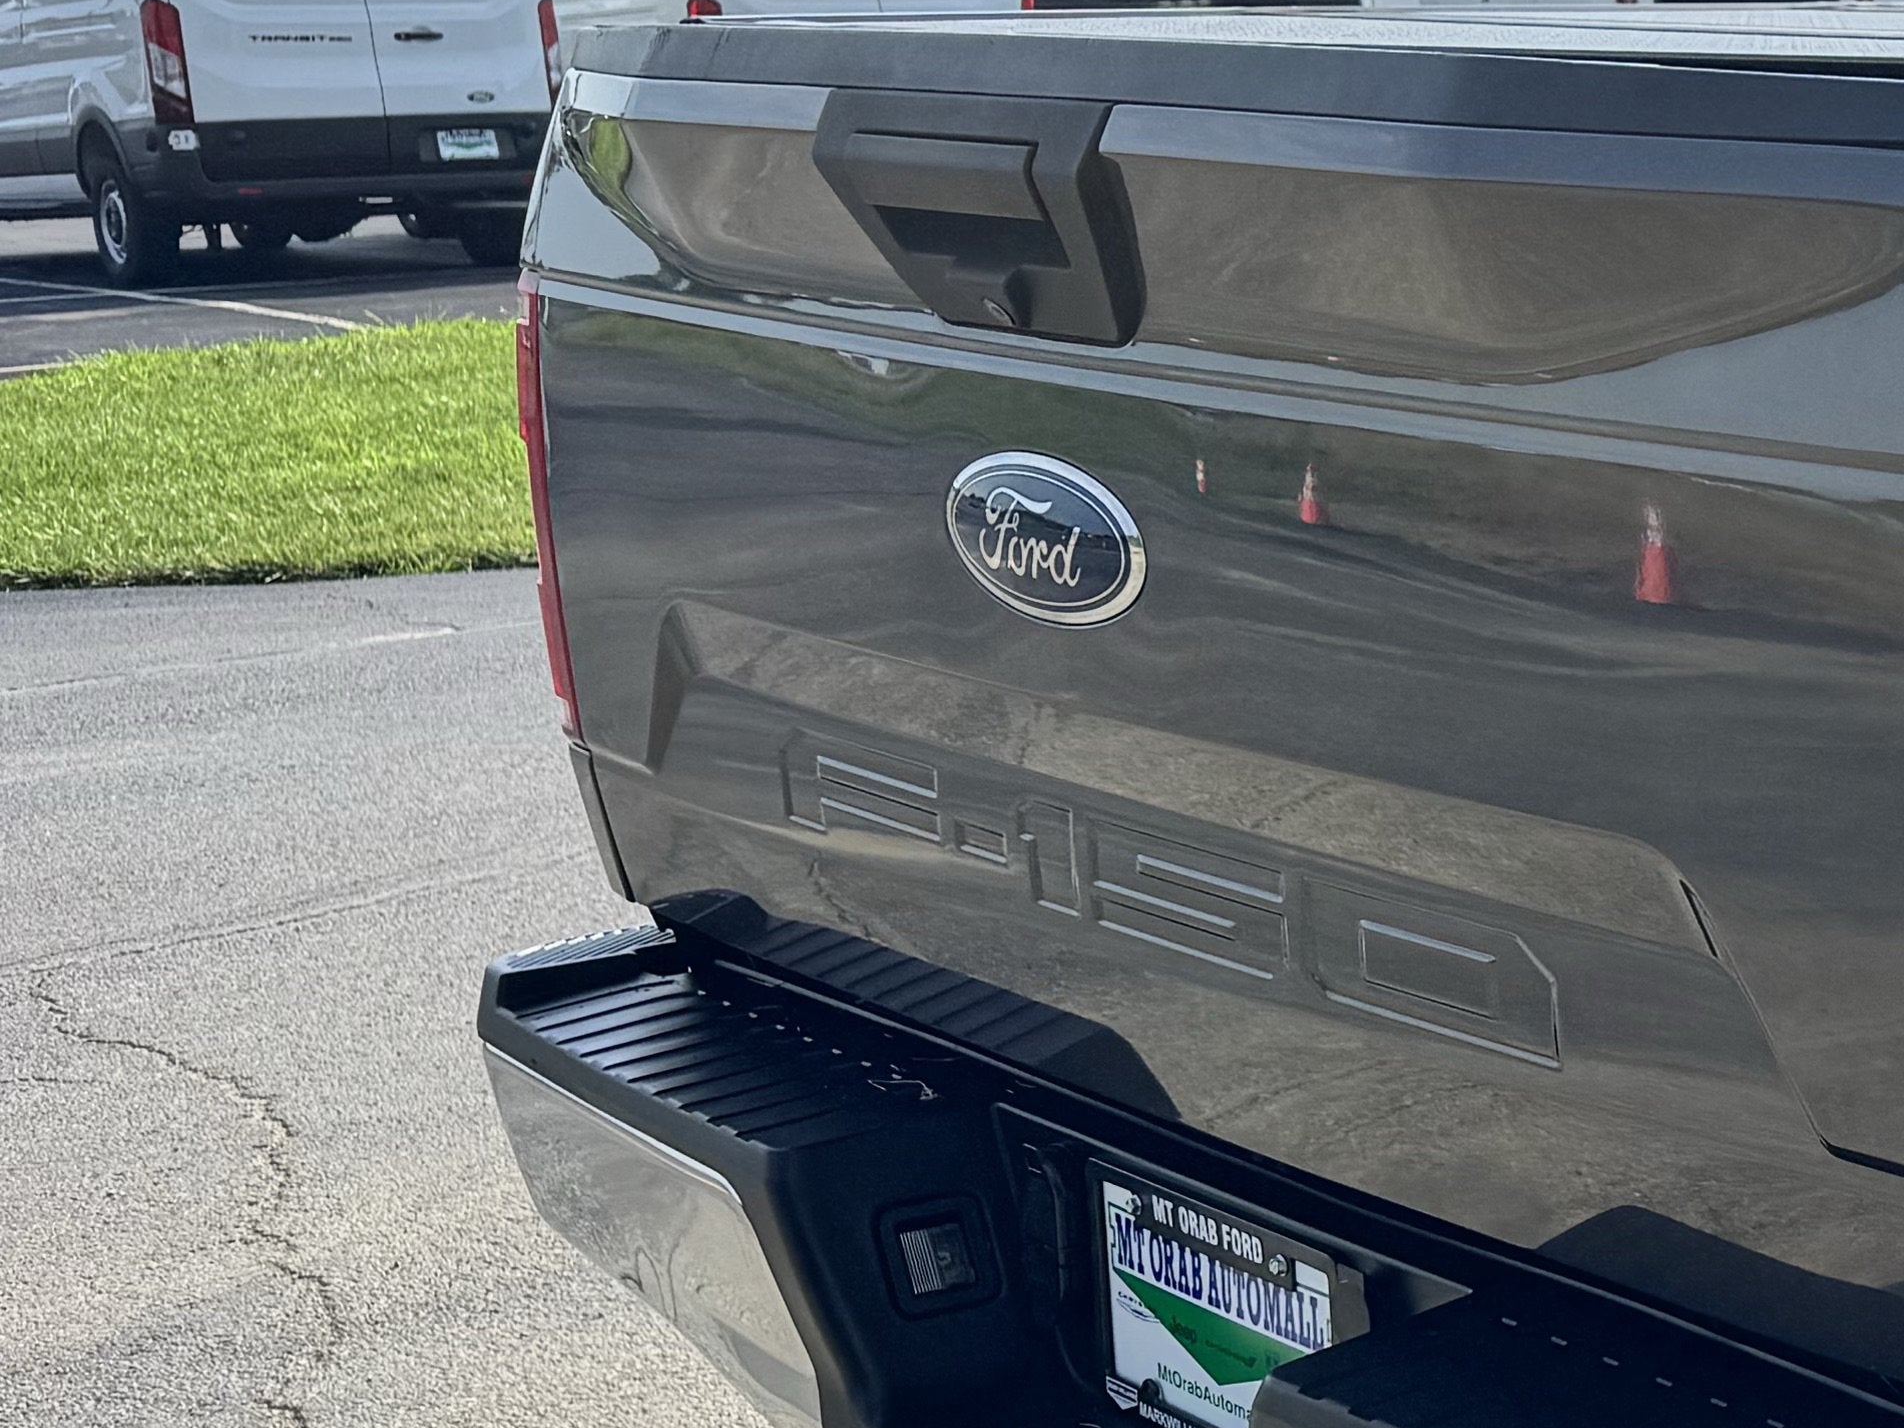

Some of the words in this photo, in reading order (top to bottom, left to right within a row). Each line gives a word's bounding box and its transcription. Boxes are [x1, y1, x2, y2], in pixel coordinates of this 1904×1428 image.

[979, 487, 1081, 587] Ford
[1152, 1195, 1174, 1227] MT
[1178, 1206, 1218, 1246] ORAB
[1221, 1224, 1263, 1264] FORD
